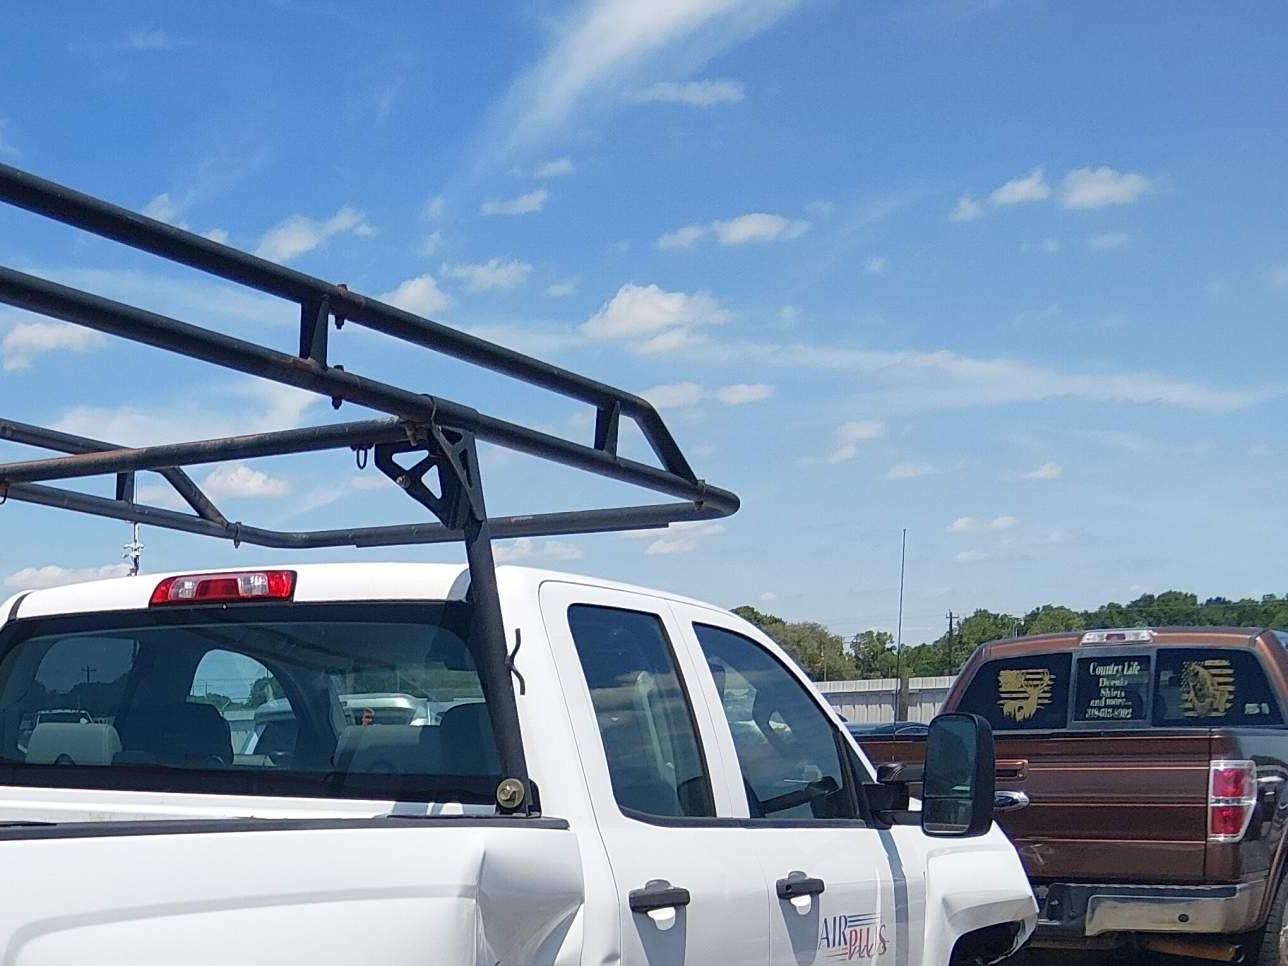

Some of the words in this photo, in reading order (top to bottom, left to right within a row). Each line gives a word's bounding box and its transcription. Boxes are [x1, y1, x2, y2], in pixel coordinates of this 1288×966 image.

[1090, 662, 1123, 677] Country
[1123, 661, 1140, 675] Life
[1089, 697, 1106, 707] and
[817, 914, 848, 949] AIR
[848, 924, 887, 961] PLUS
